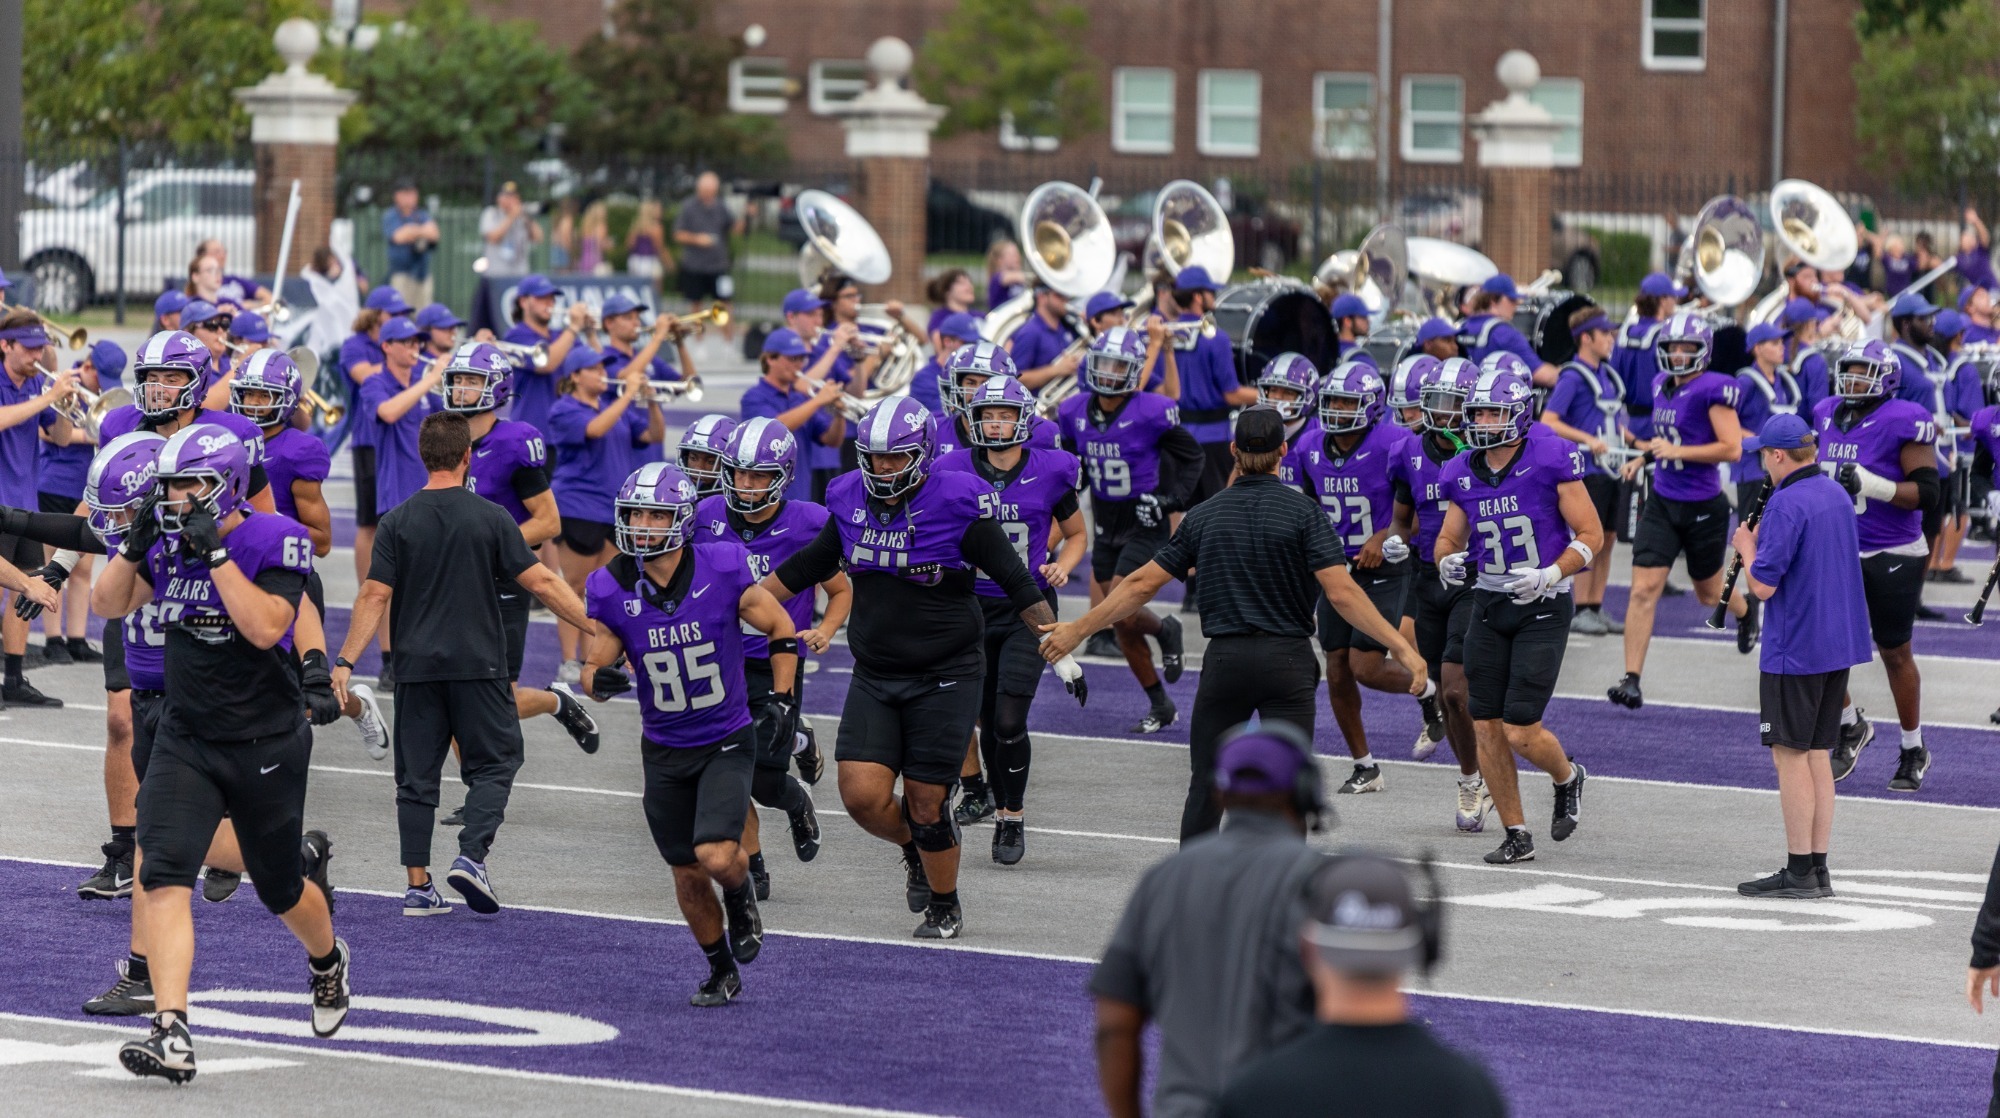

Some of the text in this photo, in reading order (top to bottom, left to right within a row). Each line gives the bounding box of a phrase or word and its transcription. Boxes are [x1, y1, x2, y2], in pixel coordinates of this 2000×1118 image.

[1723, 385, 1740, 407] 41
[1914, 420, 1936, 443] 70
[243, 434, 265, 465] 75
[525, 437, 545, 462] 18
[1087, 441, 1121, 458] BEARS
[1827, 443, 1858, 460] BEARS
[1323, 477, 1360, 493] BEARS
[977, 491, 1002, 519] 54
[1478, 495, 1520, 517] BEARS
[1320, 495, 1374, 546] 23
[860, 528, 907, 549] BEARS
[1476, 514, 1541, 576] 33
[282, 536, 312, 569] 63
[165, 577, 211, 601] BEARS
[647, 620, 703, 649] BEARS
[642, 641, 727, 712] 85
